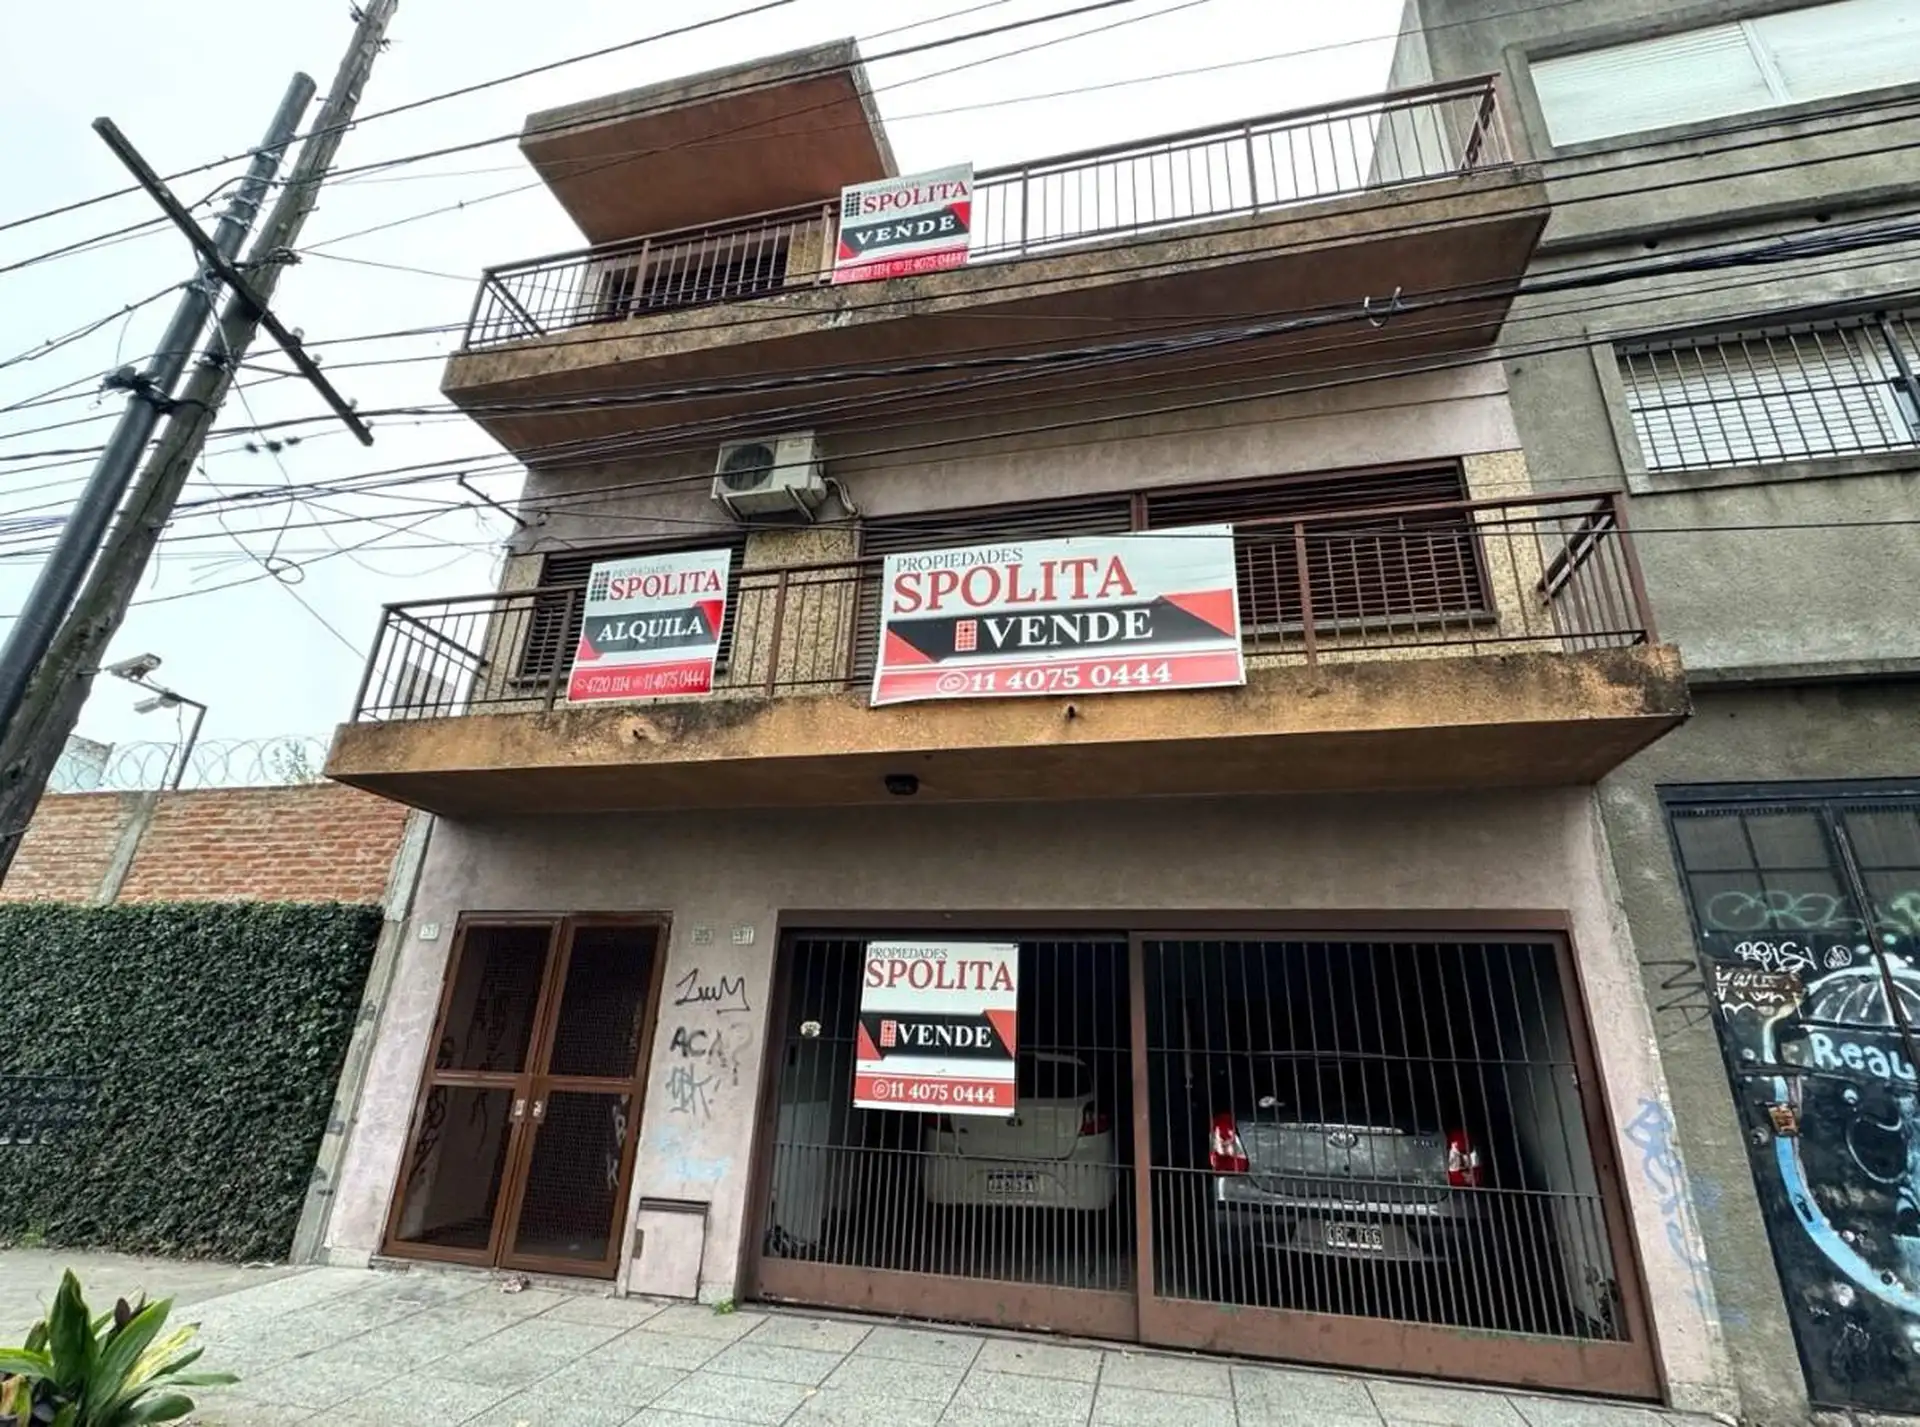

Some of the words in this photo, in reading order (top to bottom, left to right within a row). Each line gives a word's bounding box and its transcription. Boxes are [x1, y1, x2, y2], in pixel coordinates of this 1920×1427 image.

[863, 180, 968, 214] SPOLITA
[855, 214, 956, 245] VENDE
[896, 547, 1023, 573] PROPIEDADES
[610, 568, 722, 600] SPOLITA
[893, 554, 1138, 613] SPOLITA
[596, 615, 704, 643] ALQUILA
[983, 608, 1154, 649] VENDE
[971, 672, 996, 692] 11
[1006, 665, 1081, 690] 4075
[1091, 661, 1173, 687] 0444
[868, 947, 948, 960] PROPIEDADES
[865, 958, 1015, 992] SPOLITA
[898, 1023, 992, 1048] VENDE
[890, 1081, 904, 1098] 11
[908, 1083, 948, 1100] 4075
[953, 1085, 996, 1104] 0444
